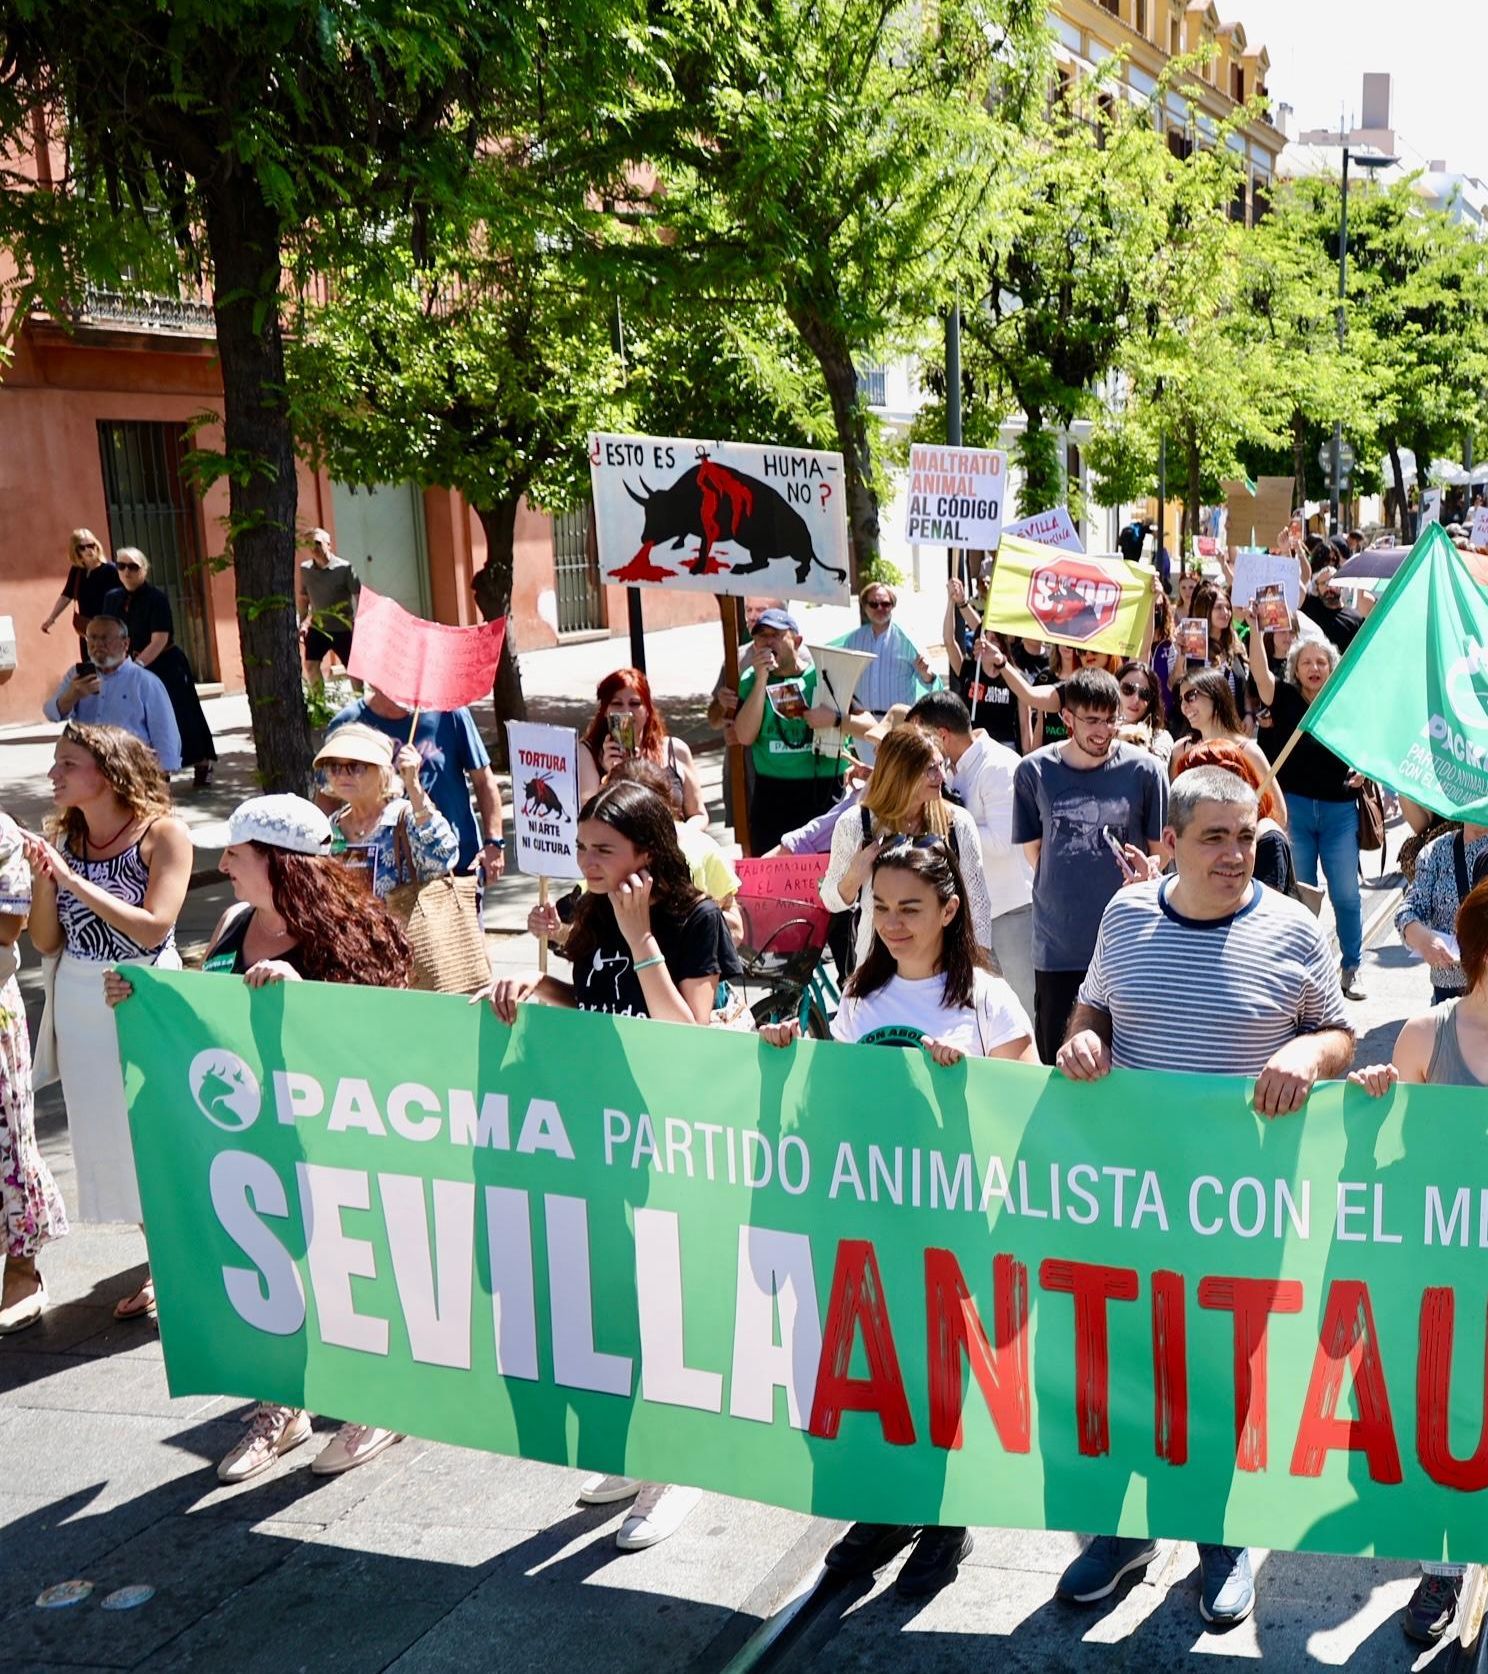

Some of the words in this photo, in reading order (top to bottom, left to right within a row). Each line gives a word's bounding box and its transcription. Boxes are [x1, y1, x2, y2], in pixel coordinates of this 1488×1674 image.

[654, 446, 676, 469] ES
[912, 450, 999, 476] MALTRATO
[911, 473, 977, 497] ANIMAL
[910, 496, 931, 516] AL
[937, 493, 998, 520] CÓDIGO
[909, 517, 969, 542] PENAL.
[518, 749, 567, 773] TORTURA
[1399, 759, 1422, 780] CON
[1406, 742, 1457, 780] PARTIDO
[528, 820, 537, 833] NI
[538, 822, 561, 837] ARTE
[522, 836, 531, 848] NI
[533, 839, 571, 856] CULTURA
[758, 883, 773, 895] EL
[785, 879, 815, 891] ARTE
[577, 1002, 648, 1019] artido
[273, 1069, 577, 1161] PACMA
[602, 1108, 811, 1195] PARTIDO
[828, 1140, 1170, 1232] ANIMALISTA
[1188, 1174, 1312, 1241] CON
[1336, 1181, 1403, 1245] EL
[209, 1149, 824, 1434] SEVILLA
